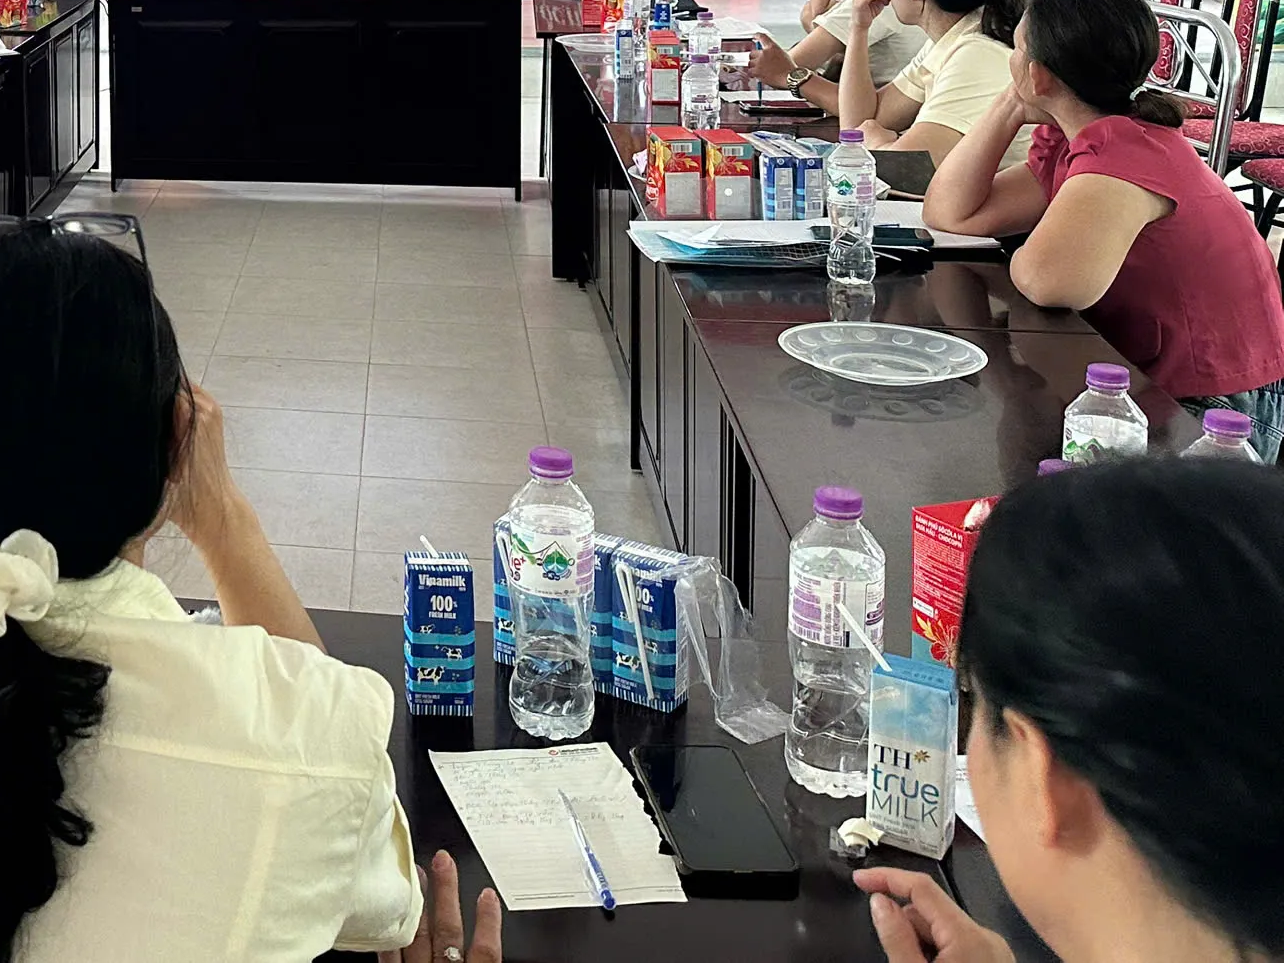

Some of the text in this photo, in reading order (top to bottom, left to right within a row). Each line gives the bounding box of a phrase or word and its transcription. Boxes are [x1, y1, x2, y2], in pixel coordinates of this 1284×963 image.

[418, 574, 466, 588] Vinamilk
[874, 744, 911, 770] TH
[871, 763, 940, 805] true
[872, 788, 938, 827] MILK
